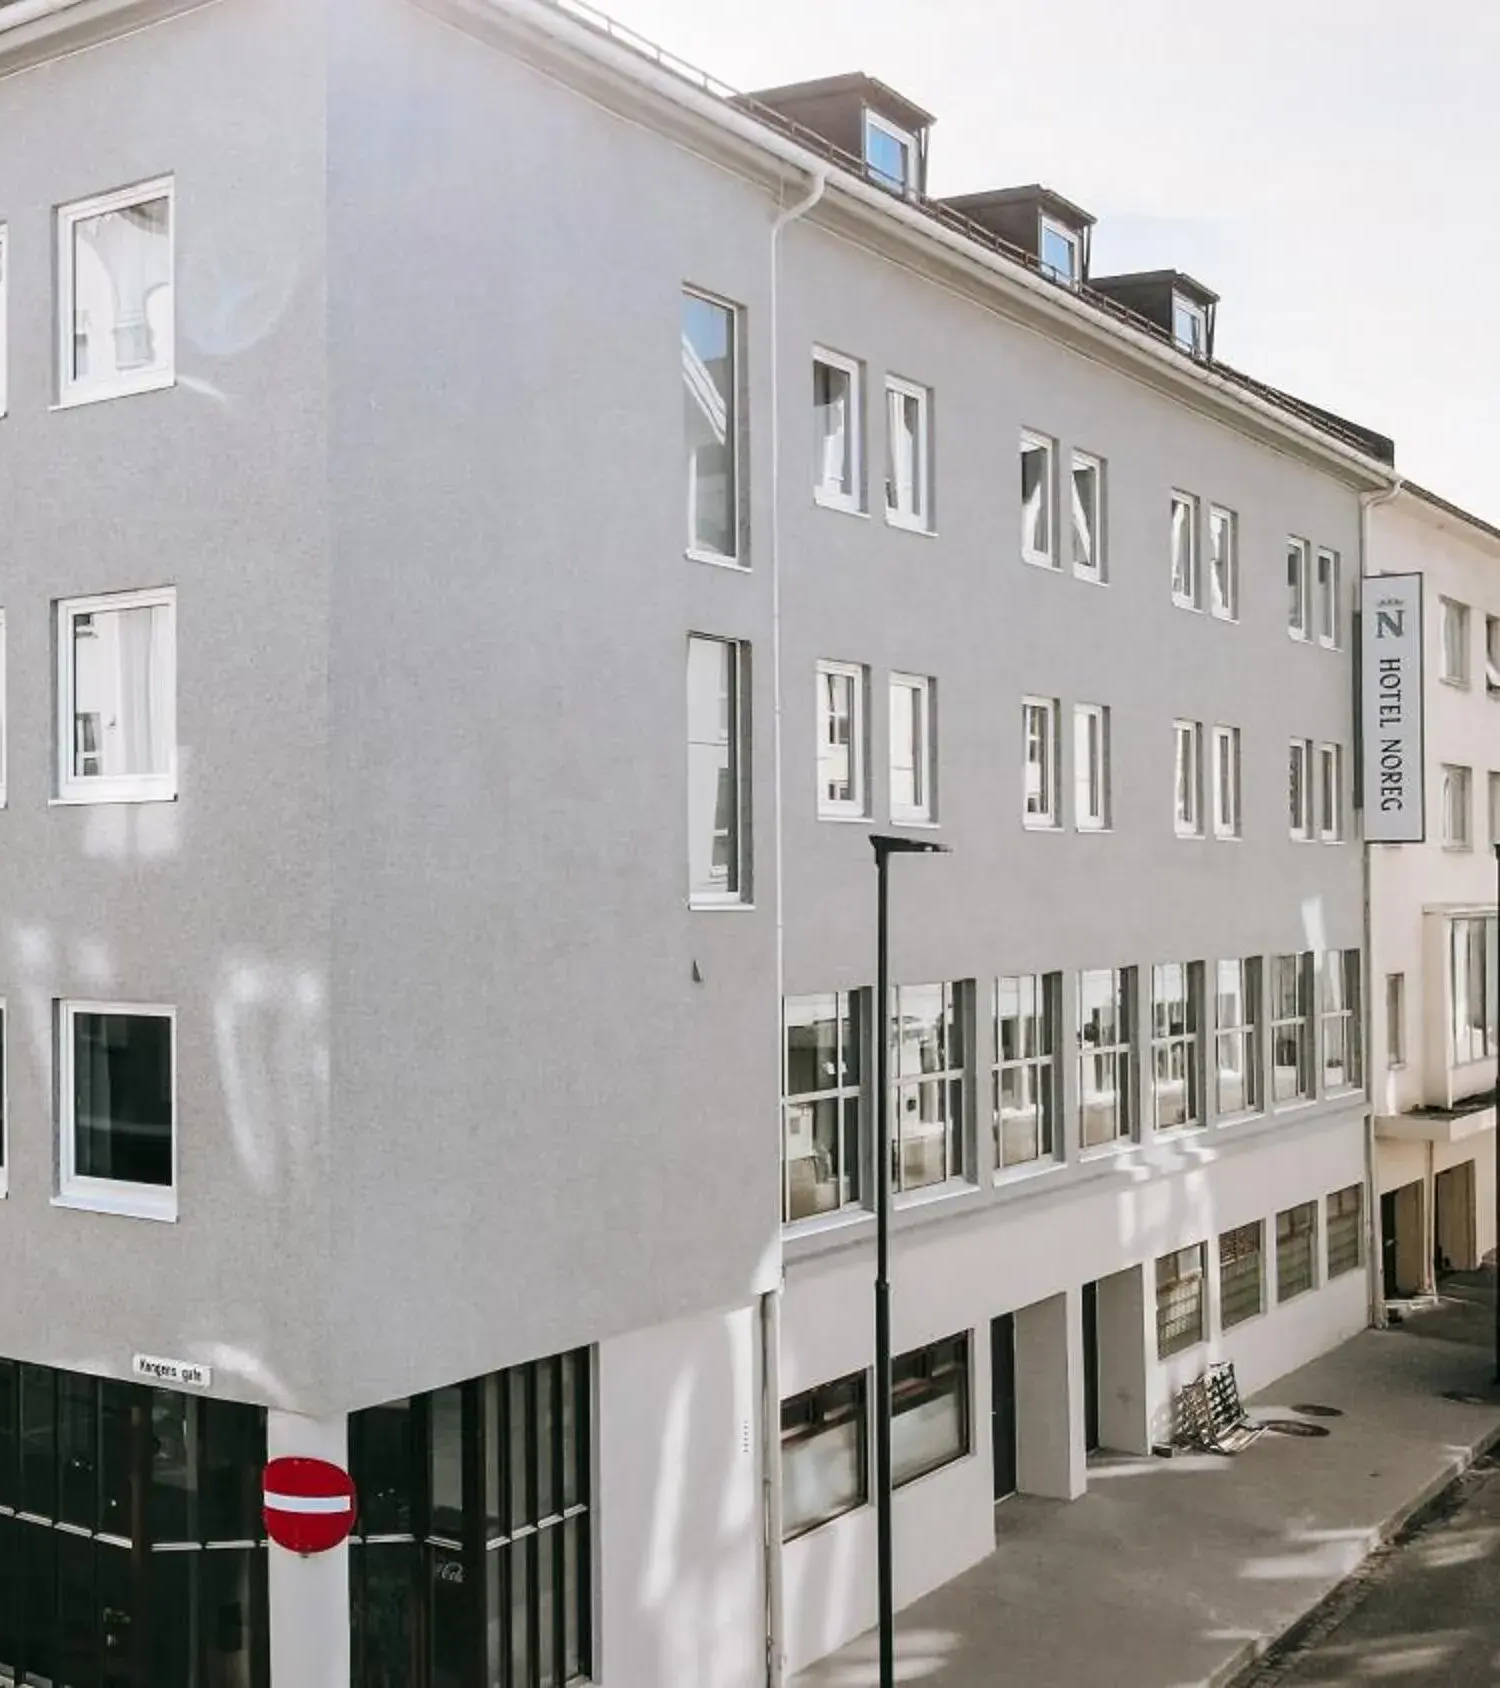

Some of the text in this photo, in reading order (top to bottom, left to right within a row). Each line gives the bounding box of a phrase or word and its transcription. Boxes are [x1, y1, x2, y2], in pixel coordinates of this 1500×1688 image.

[1375, 609, 1406, 639] N
[1379, 657, 1404, 812] HOTEL NOREG
